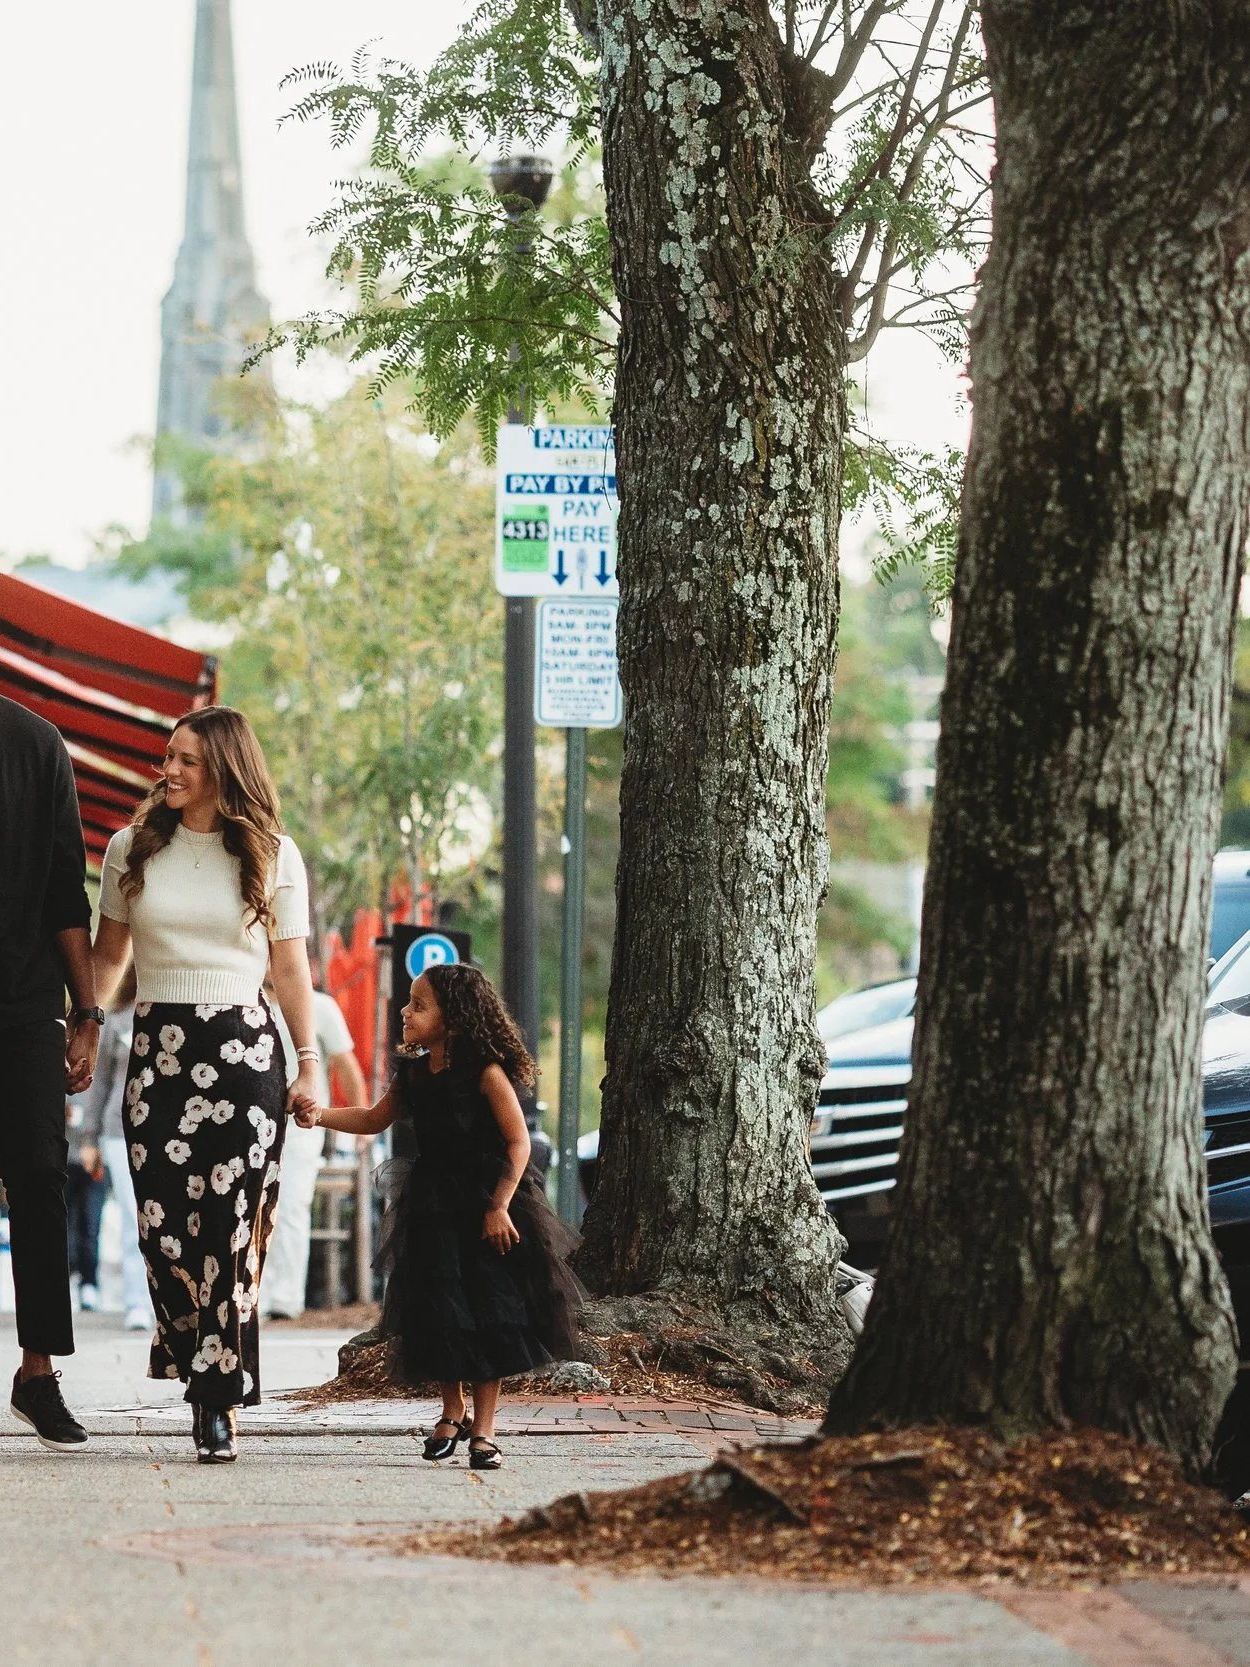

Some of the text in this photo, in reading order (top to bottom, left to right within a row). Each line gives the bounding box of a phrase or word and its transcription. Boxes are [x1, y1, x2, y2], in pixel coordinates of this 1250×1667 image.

[537, 429, 615, 448] PARKIN
[510, 476, 616, 493] PAY BY PL
[563, 500, 601, 517] PAY
[503, 520, 549, 540] 4313
[553, 526, 610, 543] HERE
